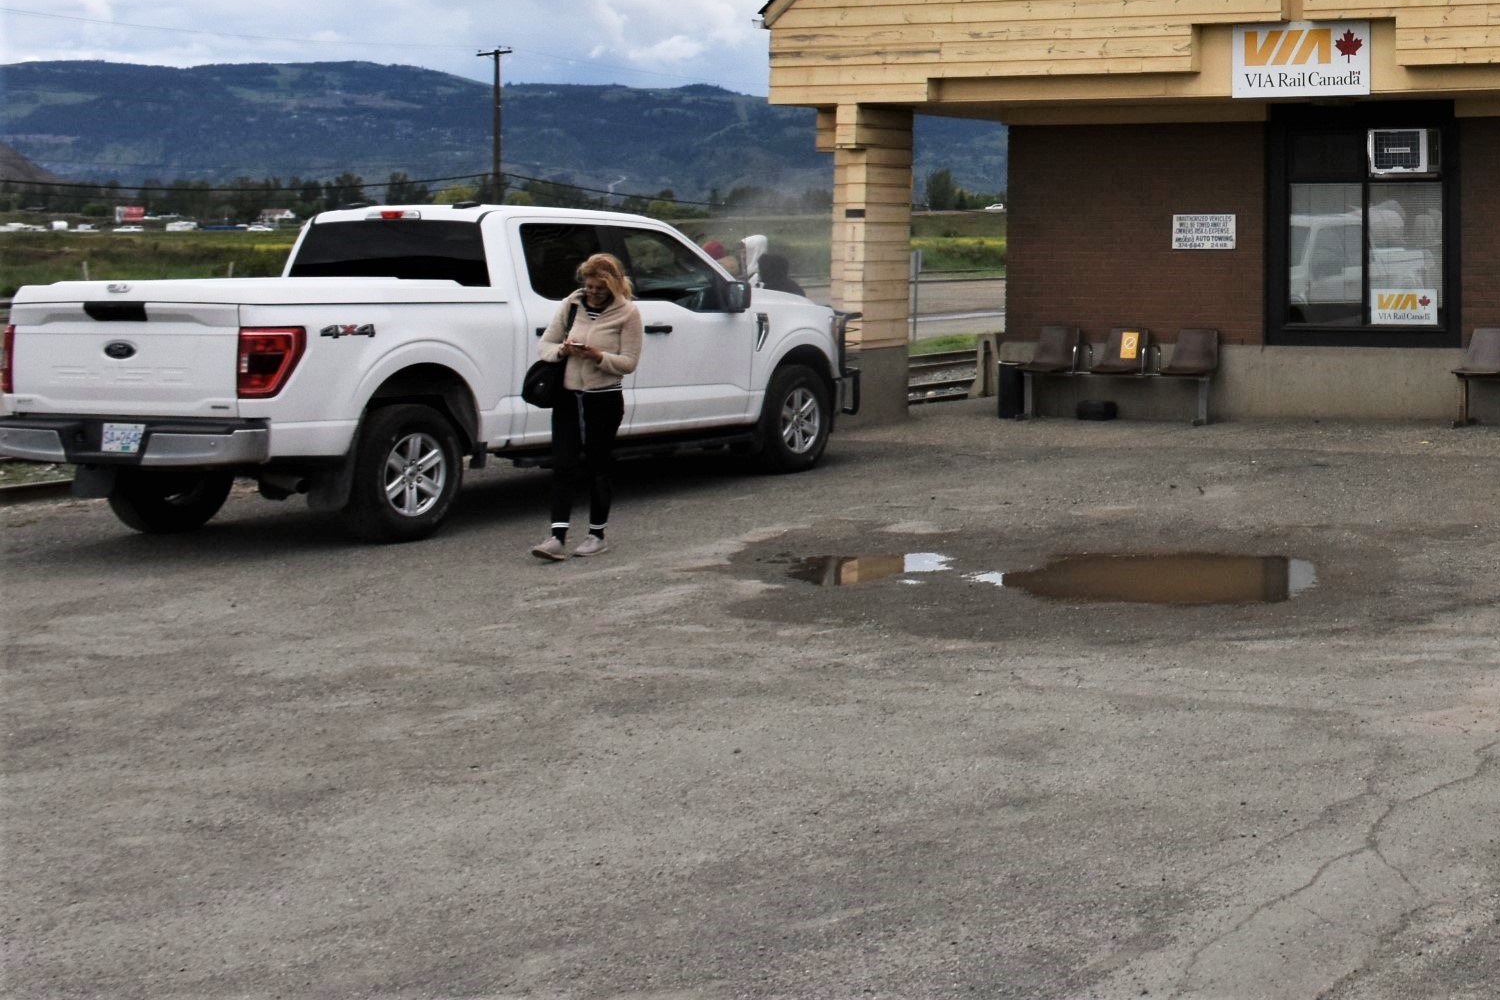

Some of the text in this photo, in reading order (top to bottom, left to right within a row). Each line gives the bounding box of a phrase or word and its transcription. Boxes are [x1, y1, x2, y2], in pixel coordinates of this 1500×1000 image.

[1244, 28, 1331, 66] VIA
[1245, 71, 1360, 88] VIA Rail Canada
[1378, 294, 1417, 310] VIA
